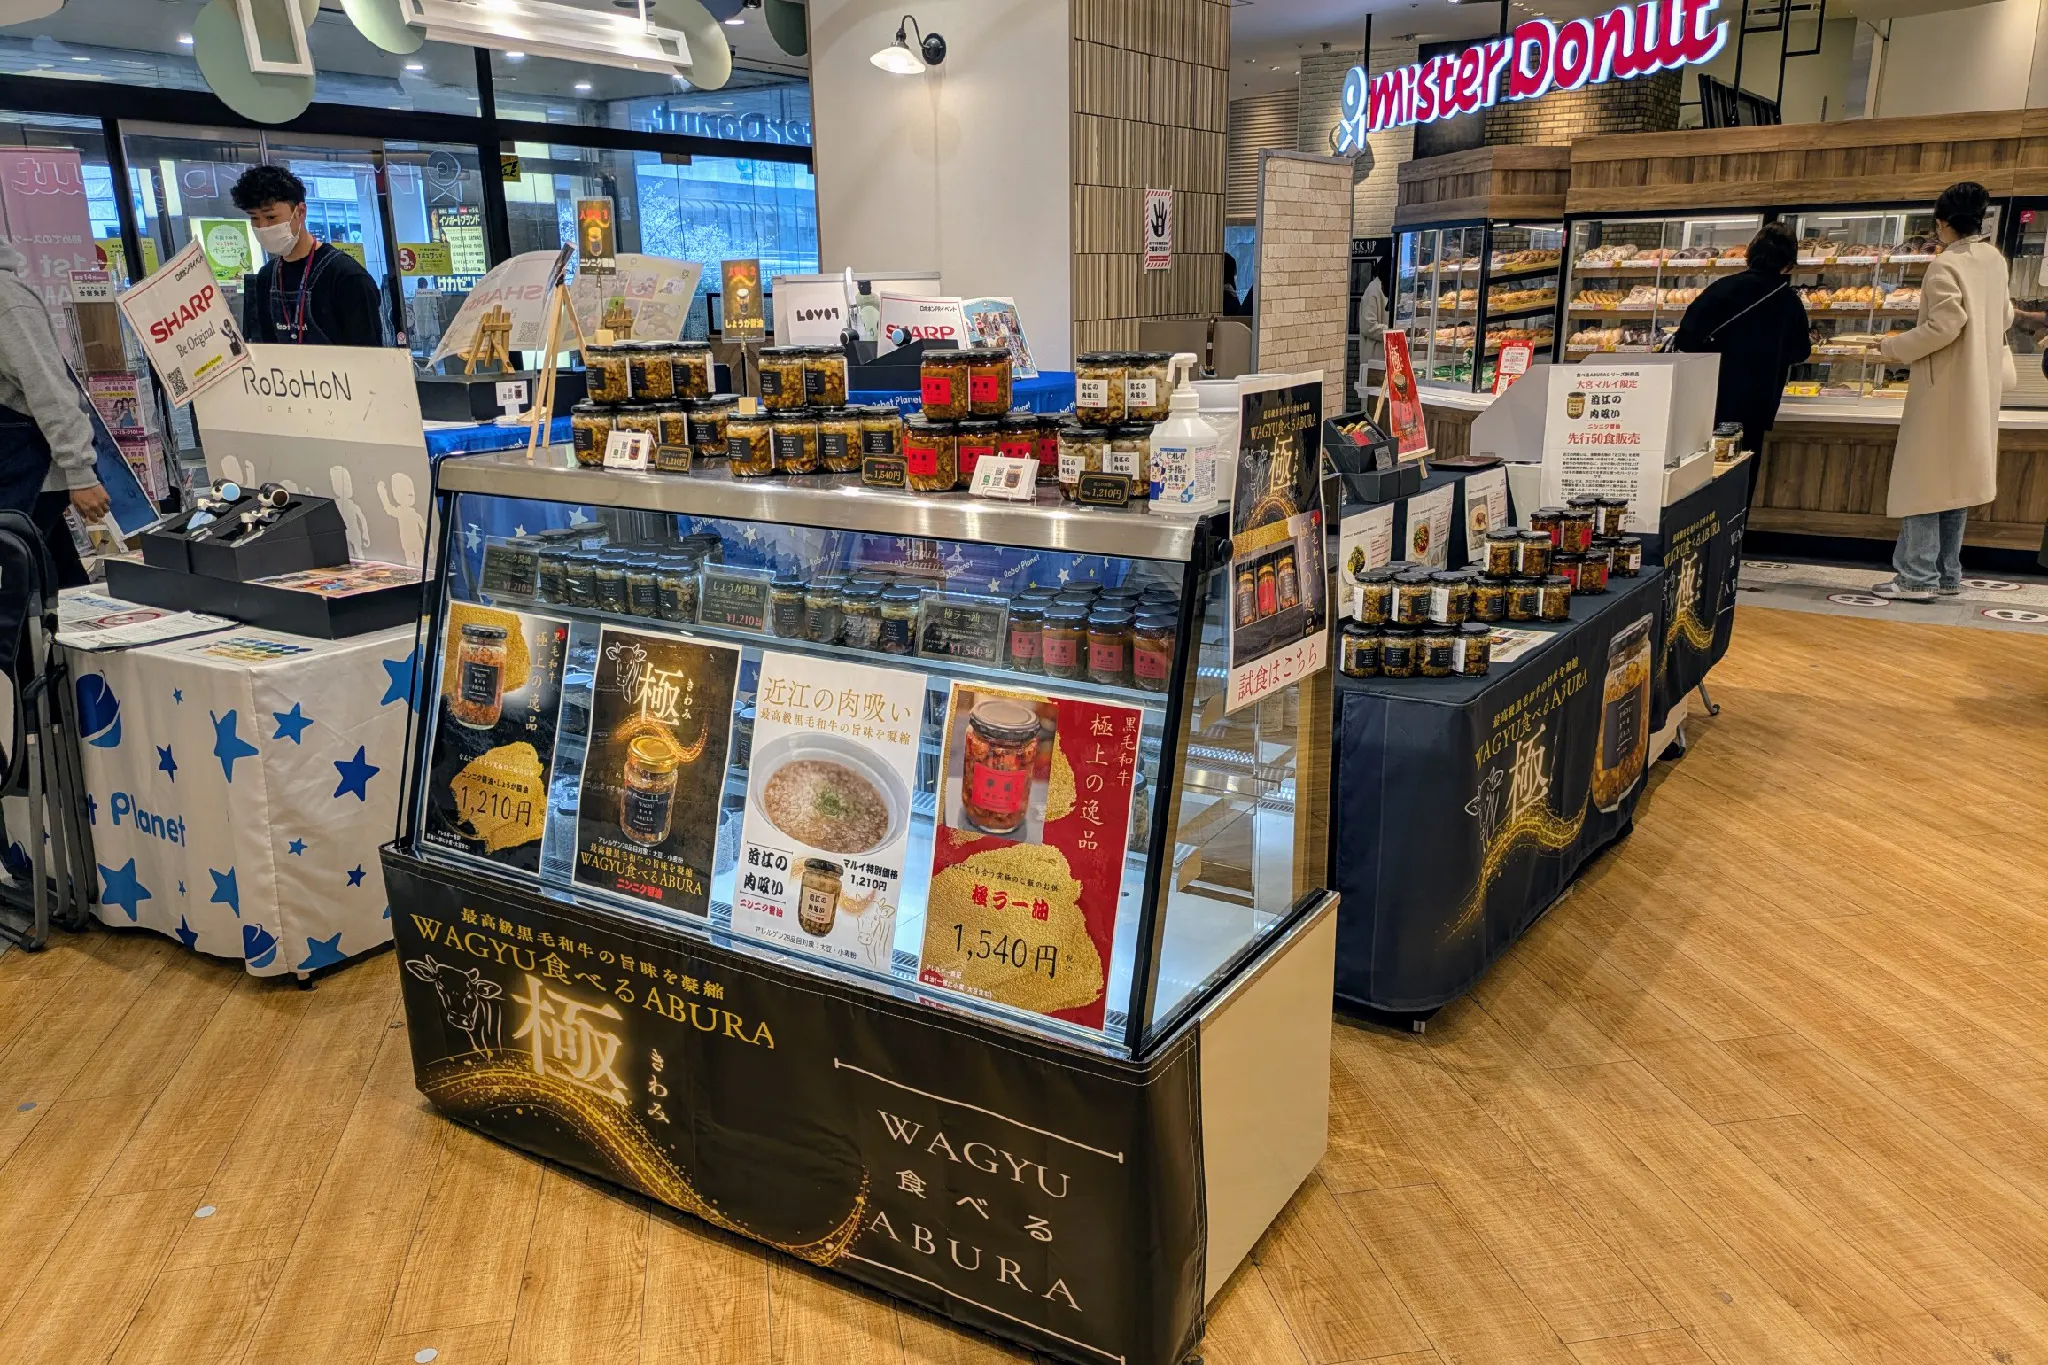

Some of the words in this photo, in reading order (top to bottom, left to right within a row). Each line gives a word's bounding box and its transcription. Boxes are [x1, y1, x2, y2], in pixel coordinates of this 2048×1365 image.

[1510, 0, 1730, 99] Donut
[1353, 241, 1364, 251] ICK
[150, 285, 214, 345] SHARP
[175, 342, 190, 359] Be
[186, 320, 218, 351] Original
[796, 307, 840, 323] LOVOT
[885, 323, 956, 341] SARP
[242, 366, 352, 401] RoBoHoN
[1576, 380, 1639, 390] 大宮マルイ限定
[1566, 431, 1641, 445] 先行50食販売
[874, 470, 901, 480] 1,540円
[1267, 435, 1294, 494] 極
[1091, 488, 1122, 500] 1,210円
[526, 631, 548, 732] 極上の逸品
[636, 661, 685, 726] 極
[1238, 642, 1318, 701] 試食はこちら
[763, 677, 912, 723] 近江の肉吸い
[760, 707, 912, 746] 最高級黒毛和牛の旨味を凝縮
[1116, 716, 1137, 787] 黒毛和牛
[1078, 712, 1114, 850] 極上の逸品
[1504, 723, 1549, 825] 極
[110, 792, 187, 848] Planet
[461, 785, 532, 828] 1,210円
[616, 878, 664, 900] ニンニク醤油
[842, 858, 899, 880] マルイ特別価格
[850, 874, 888, 892] 1,210円
[739, 898, 784, 919] ニンニク醤油
[971, 883, 1050, 922] 極ラー油
[460, 907, 725, 1001] 最高級黒毛和牛の旨味を凝縮
[953, 924, 1058, 980] 1,540円
[512, 974, 628, 1106] 極
[647, 1048, 671, 1125] きわみ
[877, 1109, 1071, 1199] WAGYU
[896, 1169, 1053, 1243] 食べる
[869, 1211, 1083, 1313] ABURA
